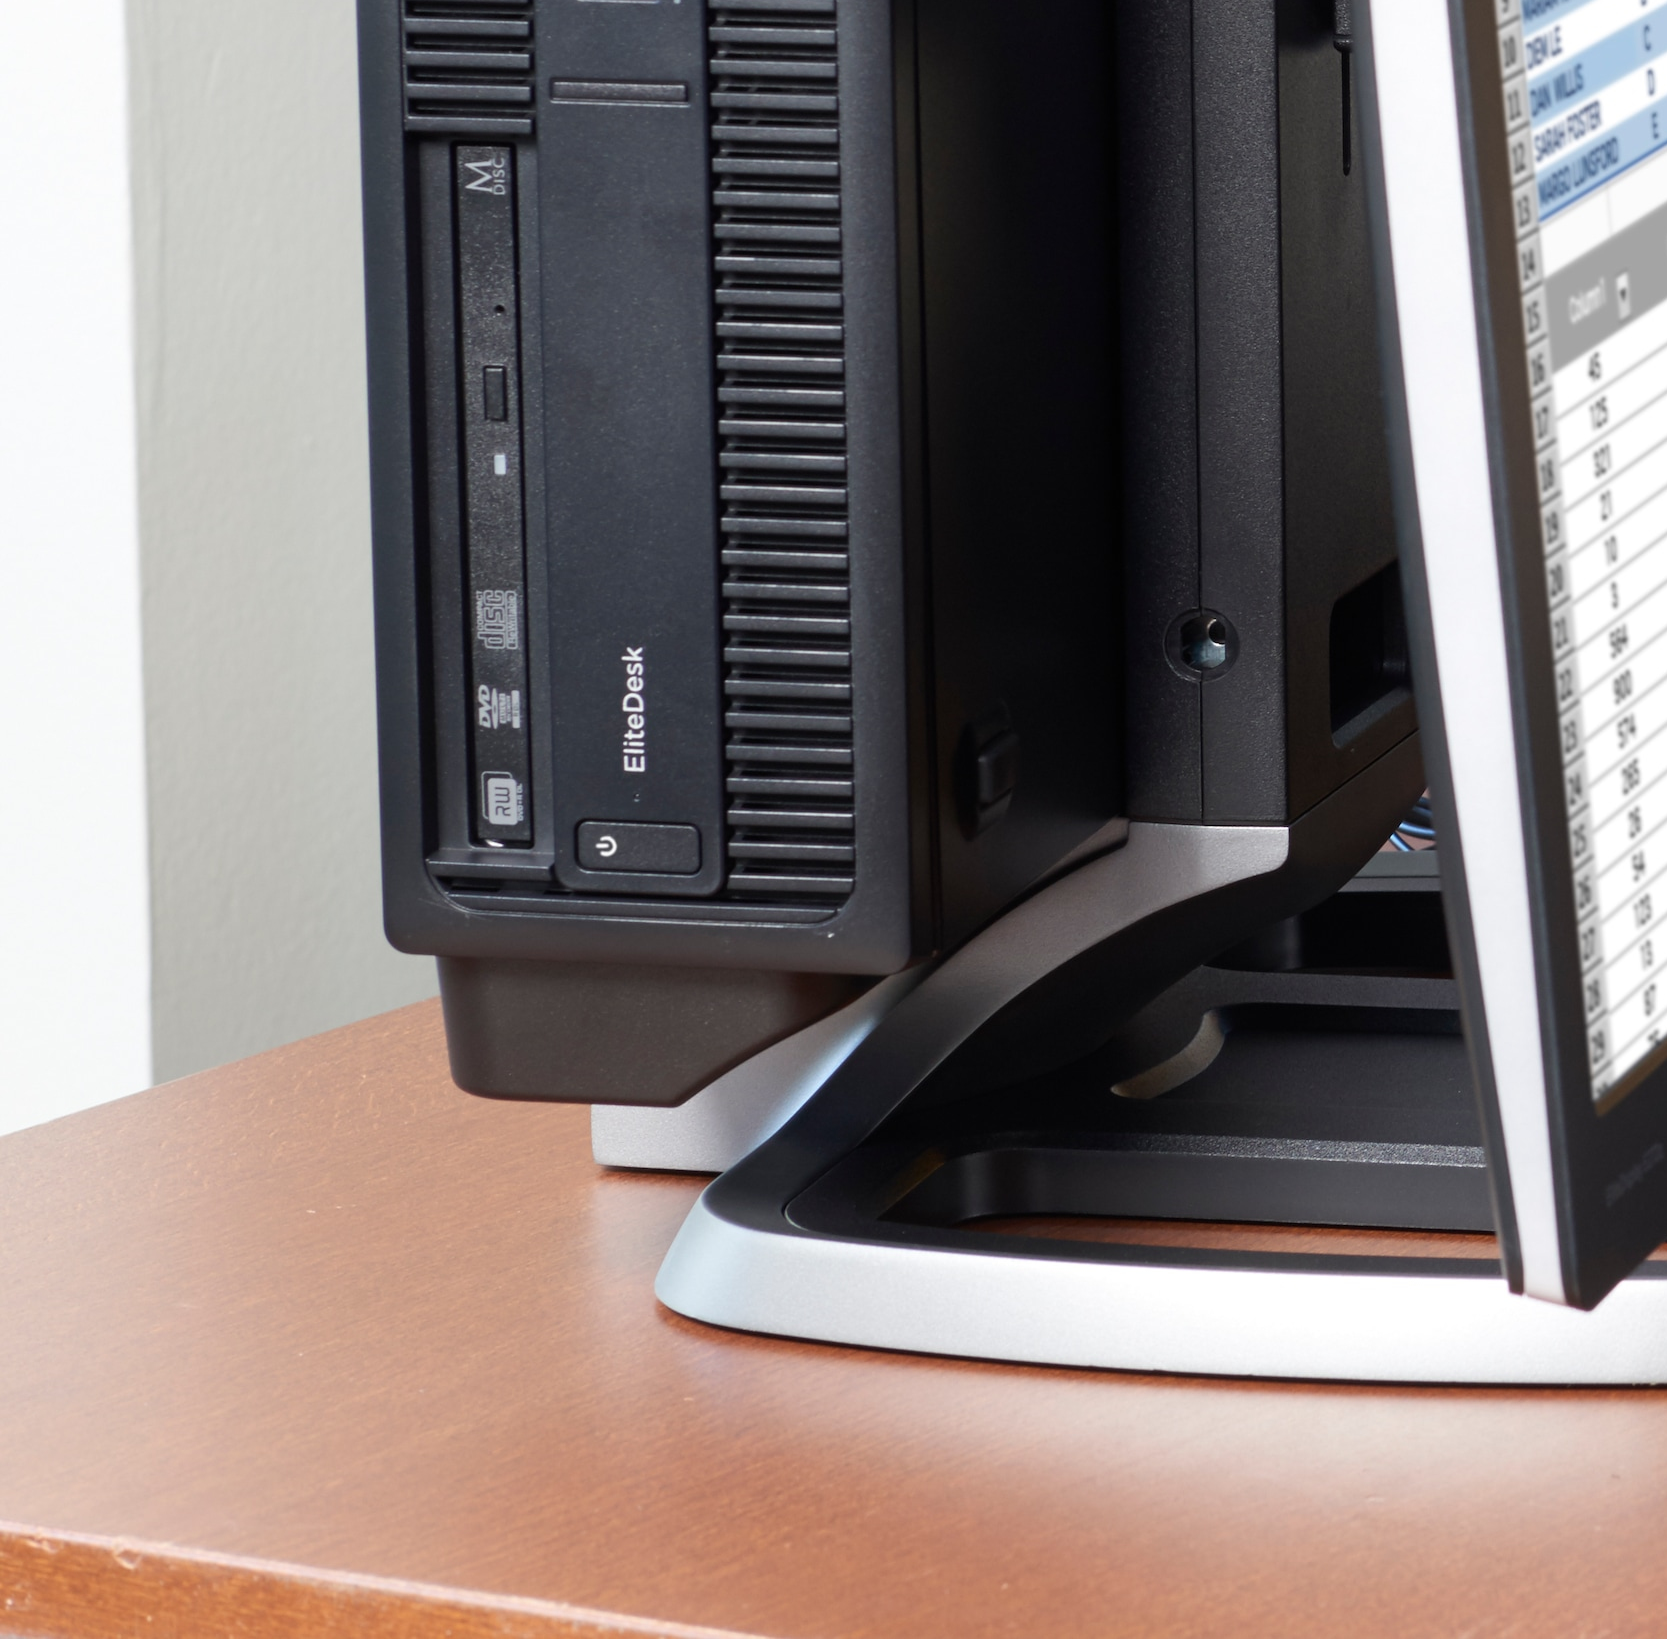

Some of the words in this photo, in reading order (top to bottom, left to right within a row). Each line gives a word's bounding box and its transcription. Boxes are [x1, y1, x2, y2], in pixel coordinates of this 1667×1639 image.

[1643, 25, 1651, 52] C
[1647, 69, 1655, 96] D
[1652, 112, 1659, 140] E
[465, 159, 493, 193] M
[493, 157, 505, 195] DISC
[1568, 276, 1607, 324] Column1
[476, 590, 485, 631] COMPACT
[477, 589, 506, 649] disc
[478, 684, 491, 728] DVD
[621, 646, 645, 772] EliteDesk
[495, 787, 511, 817] RW
